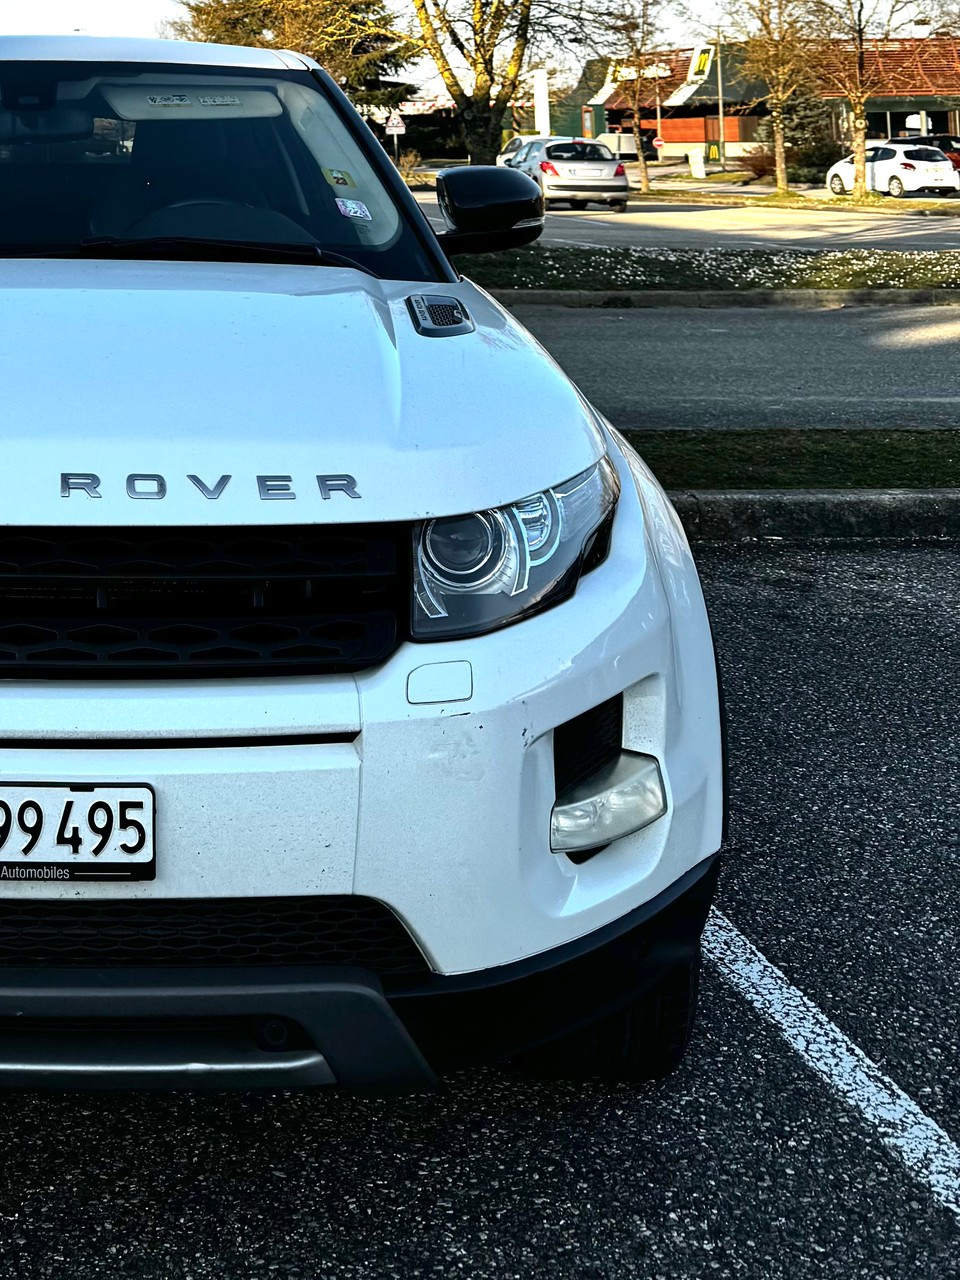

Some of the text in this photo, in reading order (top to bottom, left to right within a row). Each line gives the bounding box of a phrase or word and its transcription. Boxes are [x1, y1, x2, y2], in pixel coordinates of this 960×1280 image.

[60, 472, 363, 500] ROVER
[55, 800, 146, 857] 495
[0, 865, 70, 880] Automobiles
